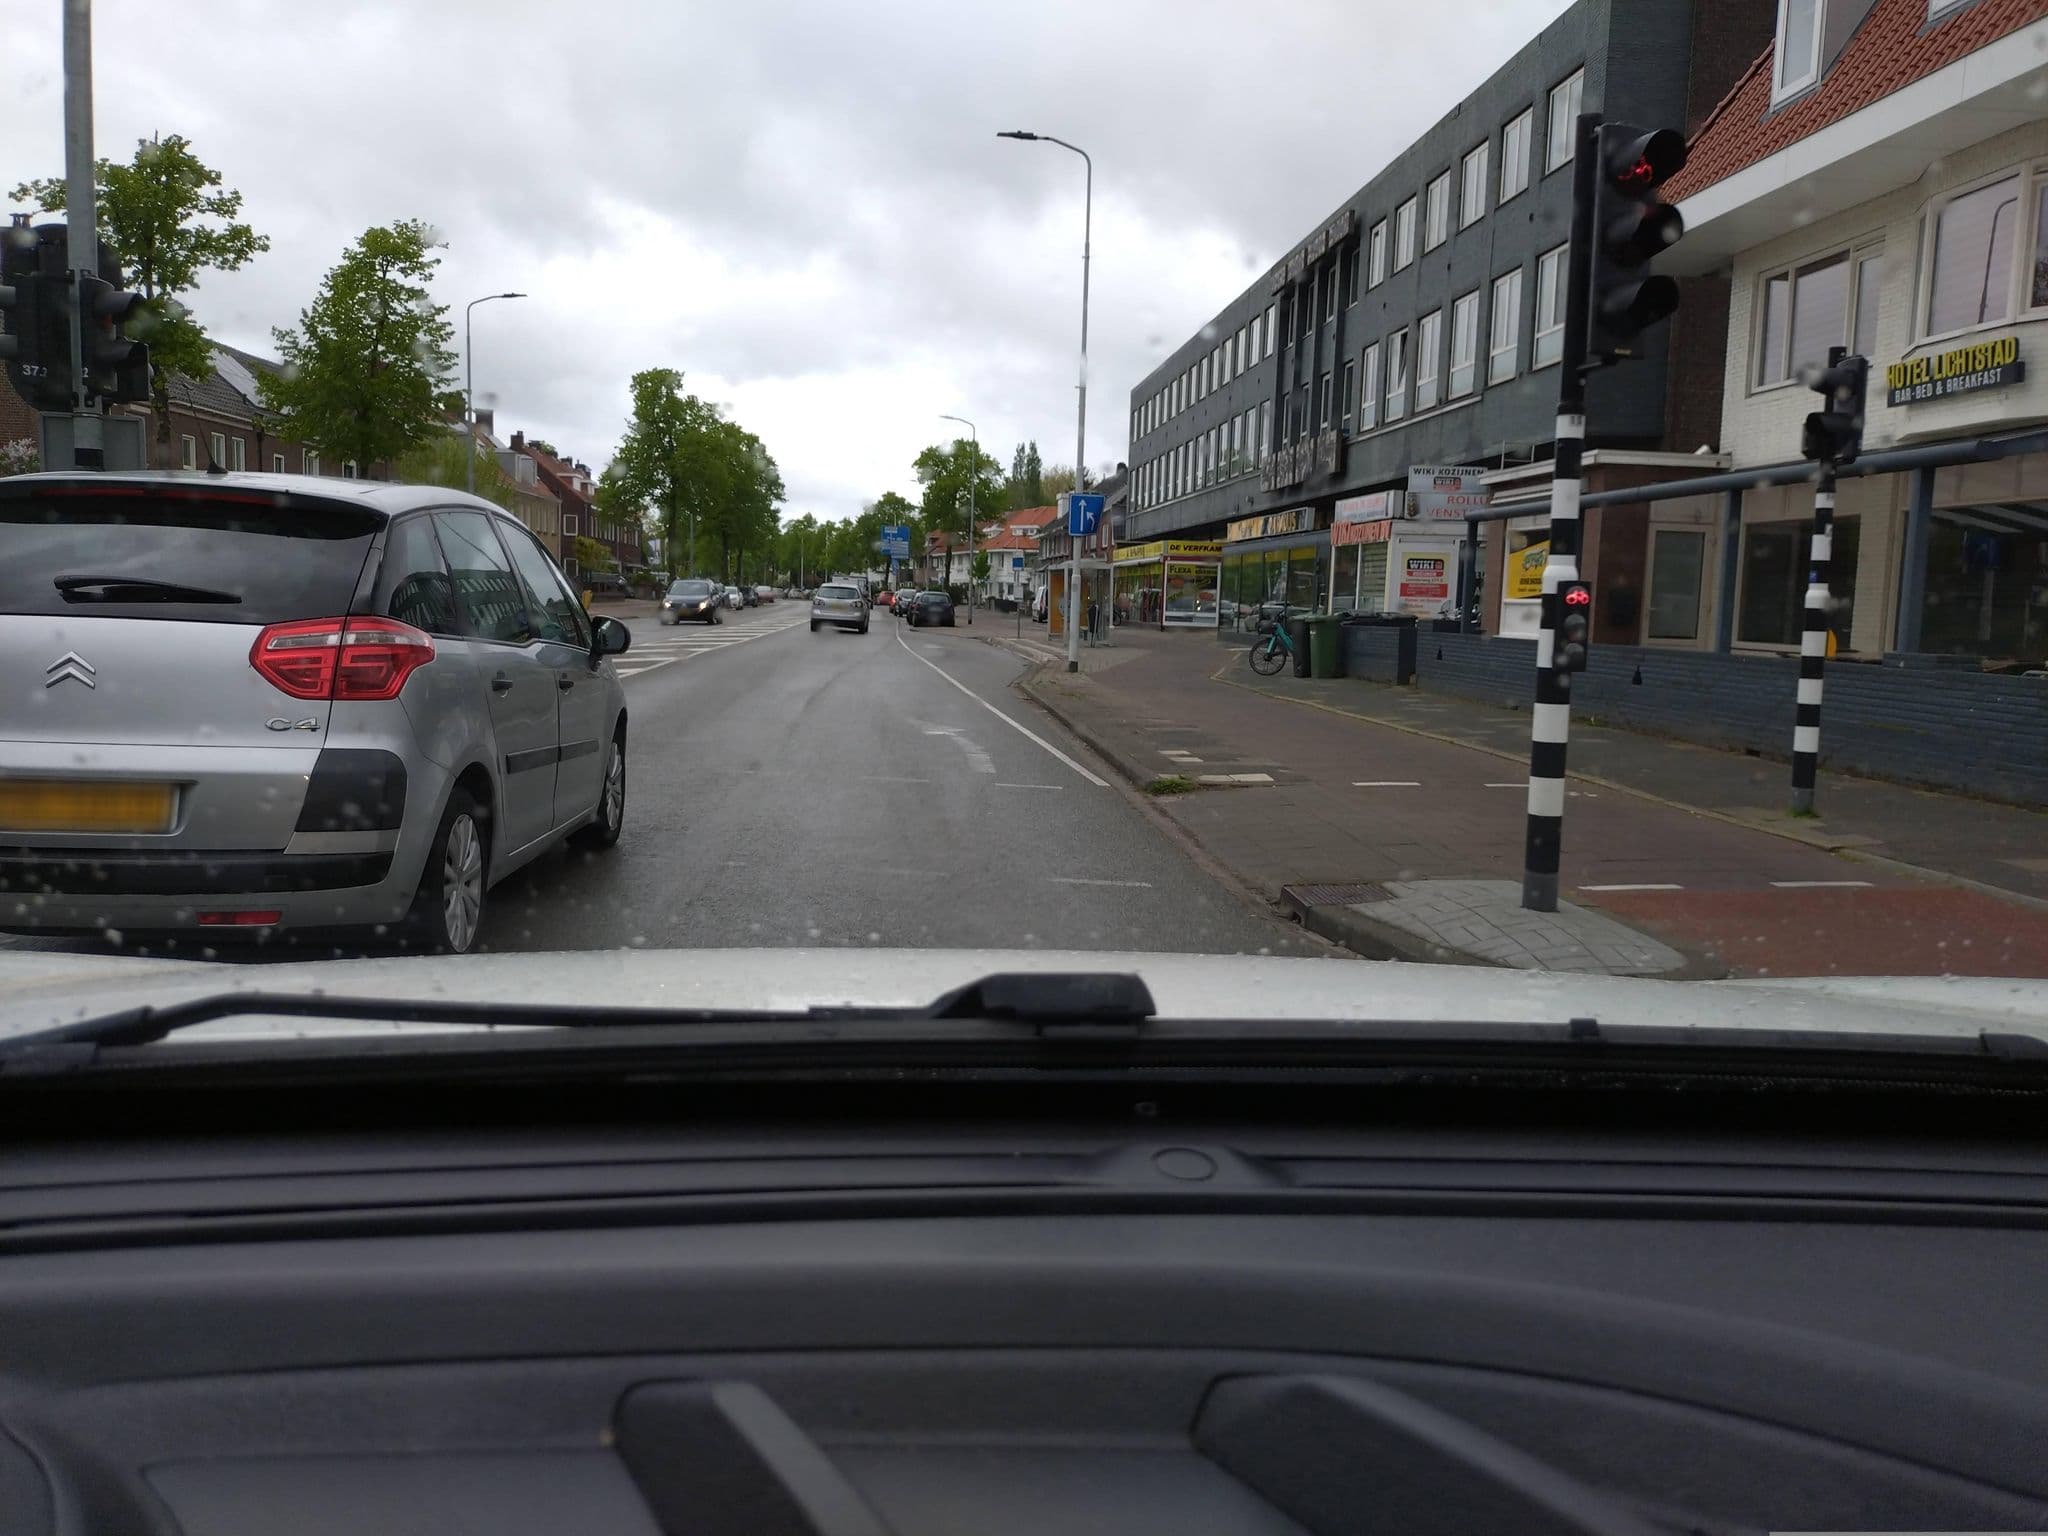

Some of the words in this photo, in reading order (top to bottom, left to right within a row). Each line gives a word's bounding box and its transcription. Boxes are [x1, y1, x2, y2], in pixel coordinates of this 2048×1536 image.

[1886, 358, 1929, 388] HOTEL
[1934, 336, 2018, 379] LICHTSTAD
[1935, 382, 1944, 395] &
[1946, 368, 2002, 393] BREAKFAST
[1438, 468, 1484, 476] KOZIJNEN
[1170, 544, 1181, 552] DE
[1409, 560, 1435, 569] WIKI
[265, 717, 321, 732] C4
